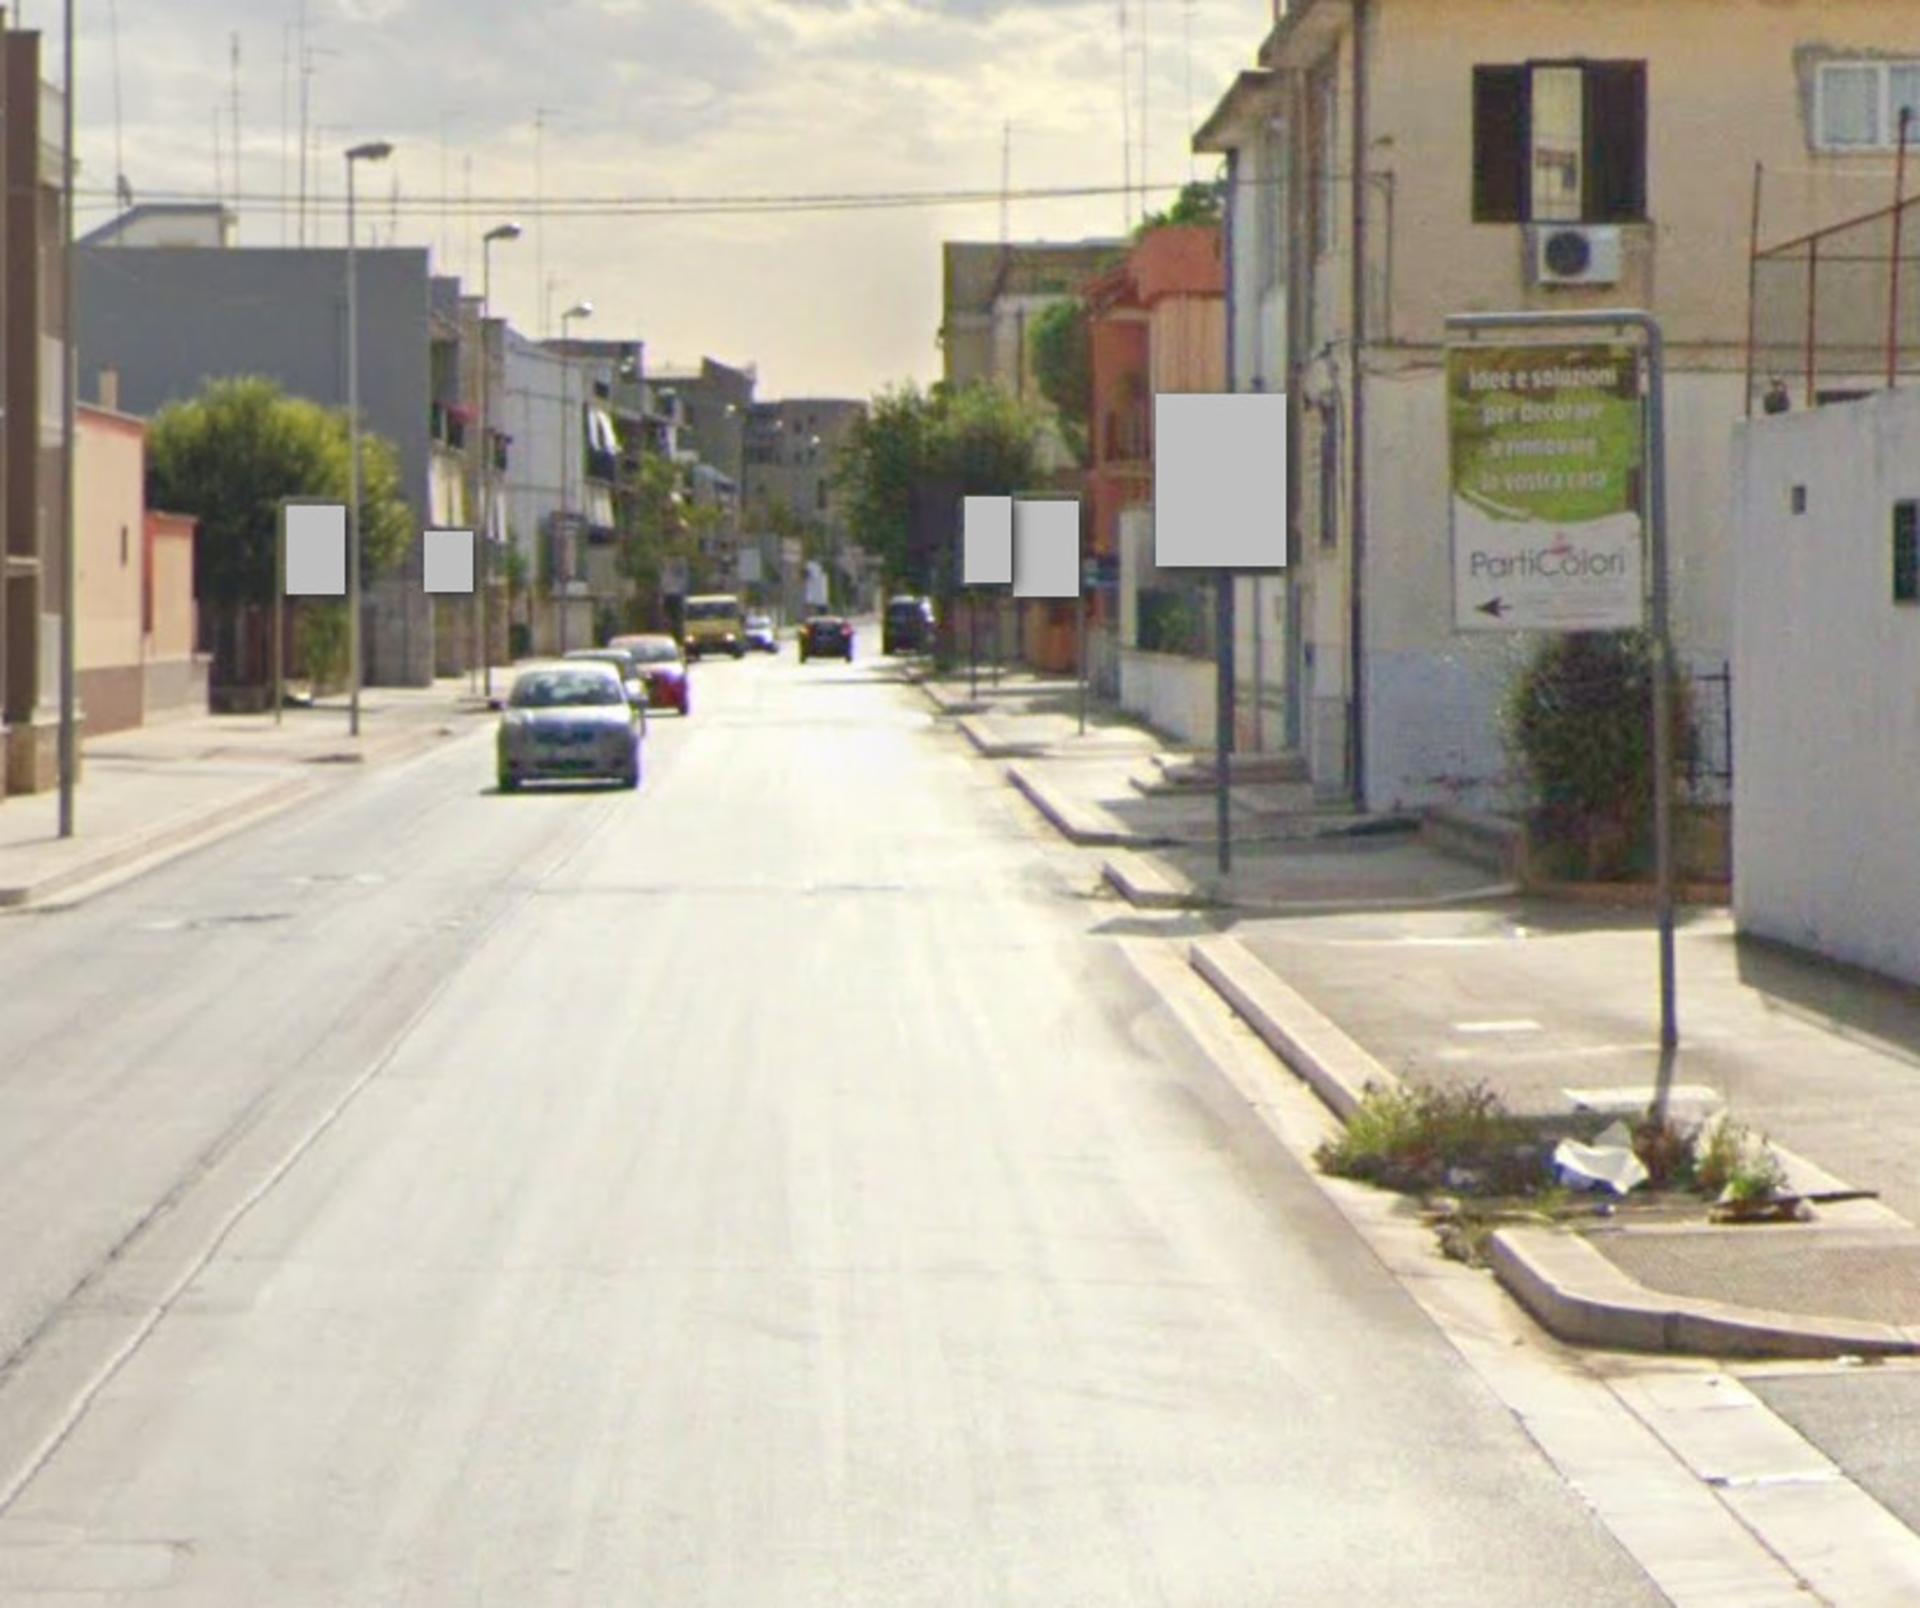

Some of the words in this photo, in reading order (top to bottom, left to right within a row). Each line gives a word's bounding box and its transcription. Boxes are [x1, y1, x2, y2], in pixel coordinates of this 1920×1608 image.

[1515, 371, 1528, 388] e
[1531, 366, 1618, 388] soluzioni
[1482, 405, 1516, 427] per
[1470, 547, 1625, 578] PartiColori
